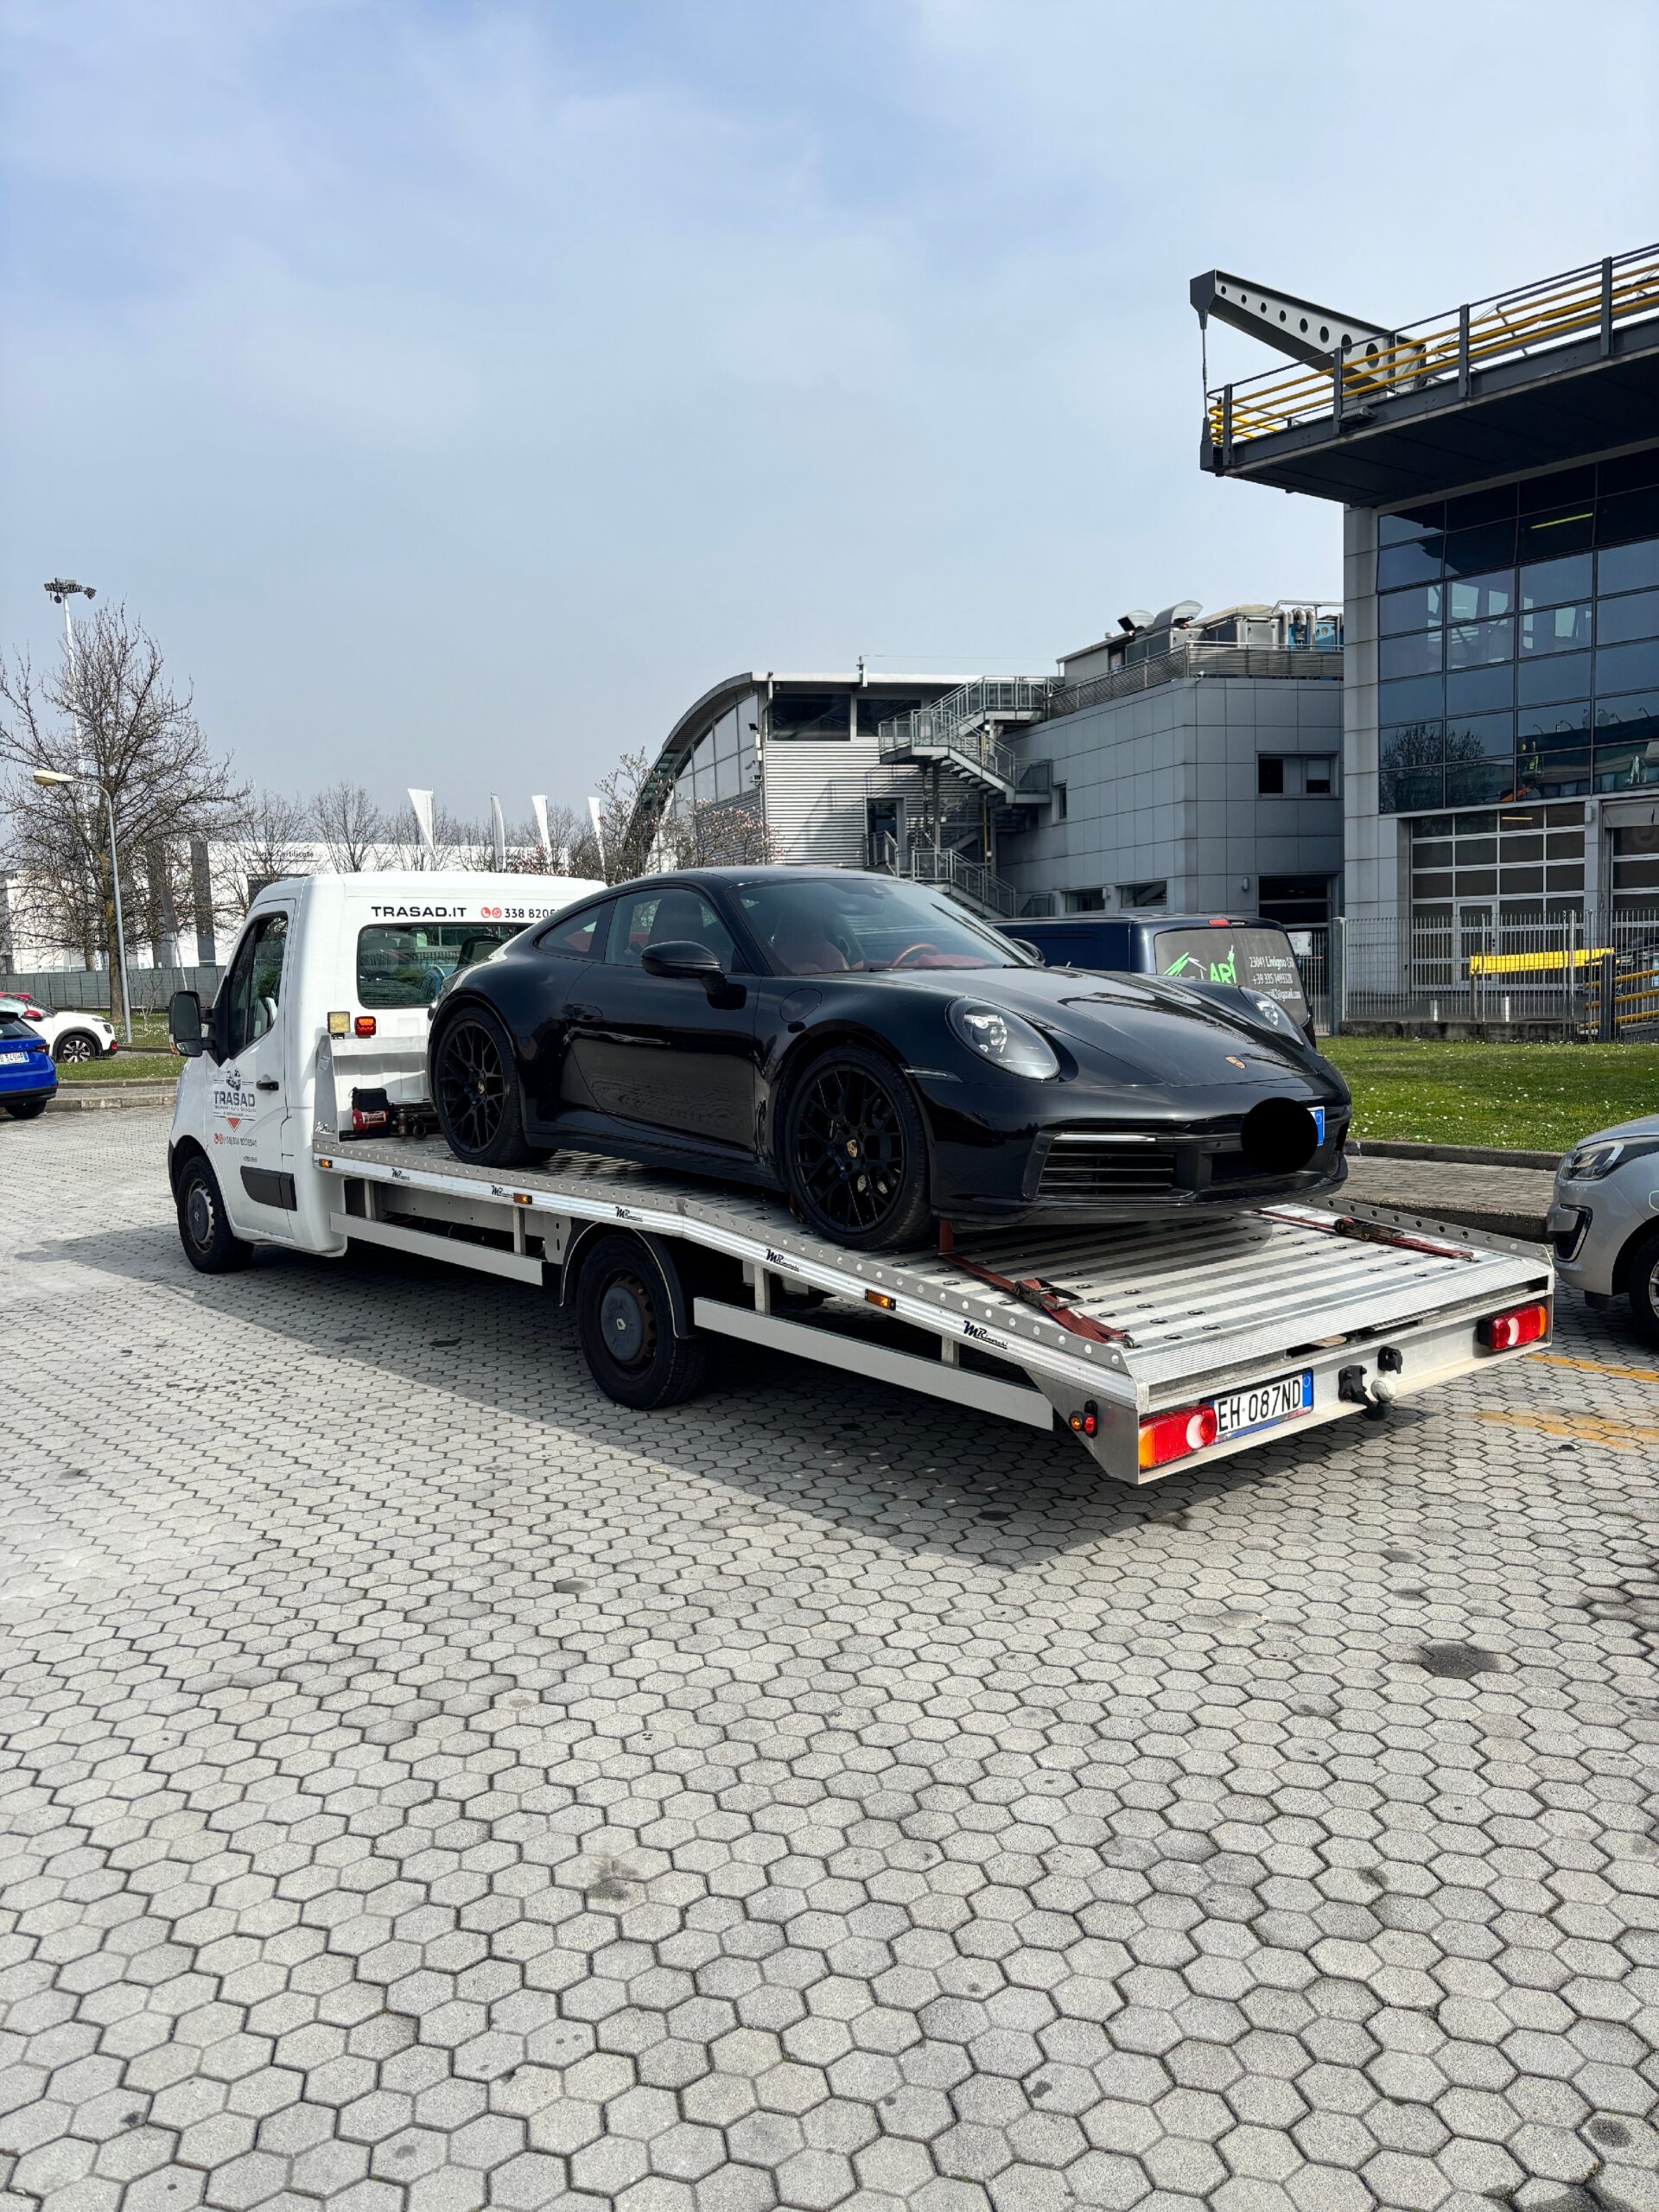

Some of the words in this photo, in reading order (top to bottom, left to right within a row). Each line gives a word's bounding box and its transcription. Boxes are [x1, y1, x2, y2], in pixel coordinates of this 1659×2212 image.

[371, 906, 467, 918] TRASAD.IT
[505, 908, 524, 918] 338
[1265, 956, 1287, 969] Livigno
[213, 1090, 256, 1107] TRASAD
[1218, 1396, 1241, 1433] EH
[1249, 1379, 1301, 1423] 087ND
